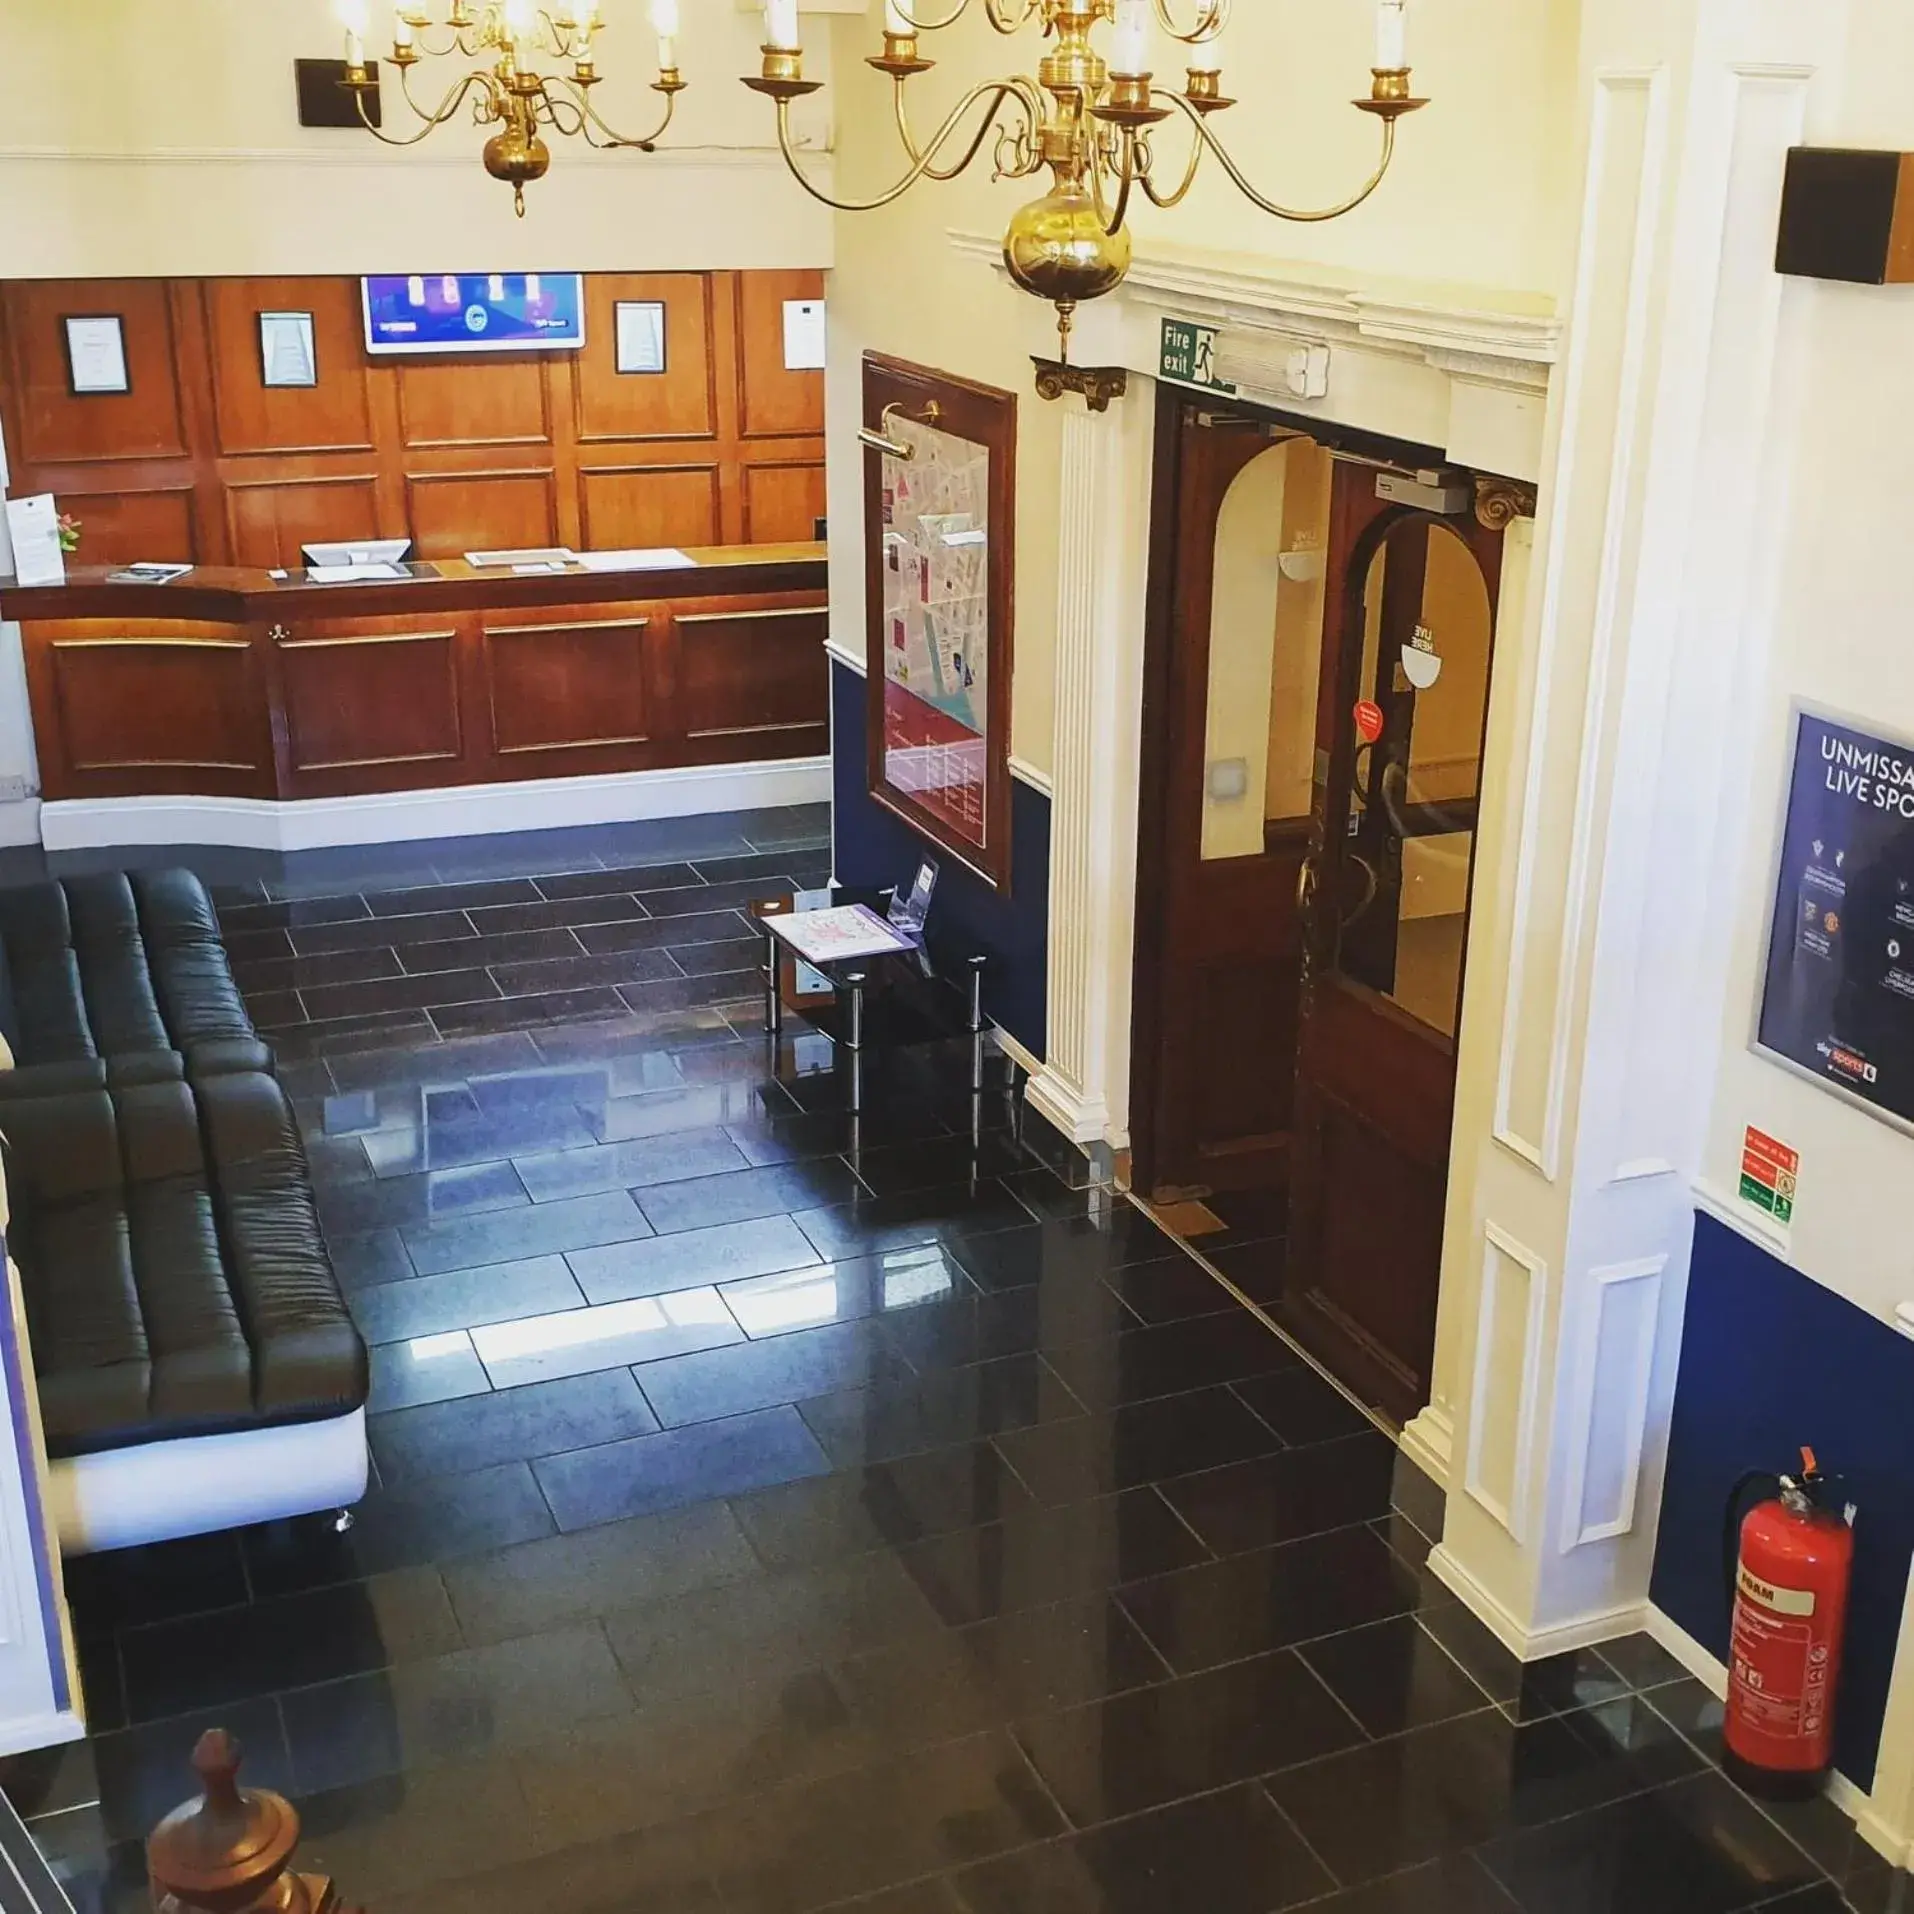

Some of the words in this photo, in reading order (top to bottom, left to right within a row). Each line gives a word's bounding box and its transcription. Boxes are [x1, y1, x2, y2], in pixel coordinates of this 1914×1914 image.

[1165, 326, 1190, 350] Fire
[1164, 354, 1187, 374] exit
[1821, 735, 1914, 791] UNMISSA
[1825, 766, 1871, 802] LIVE
[1742, 1572, 1775, 1602] FOAM
